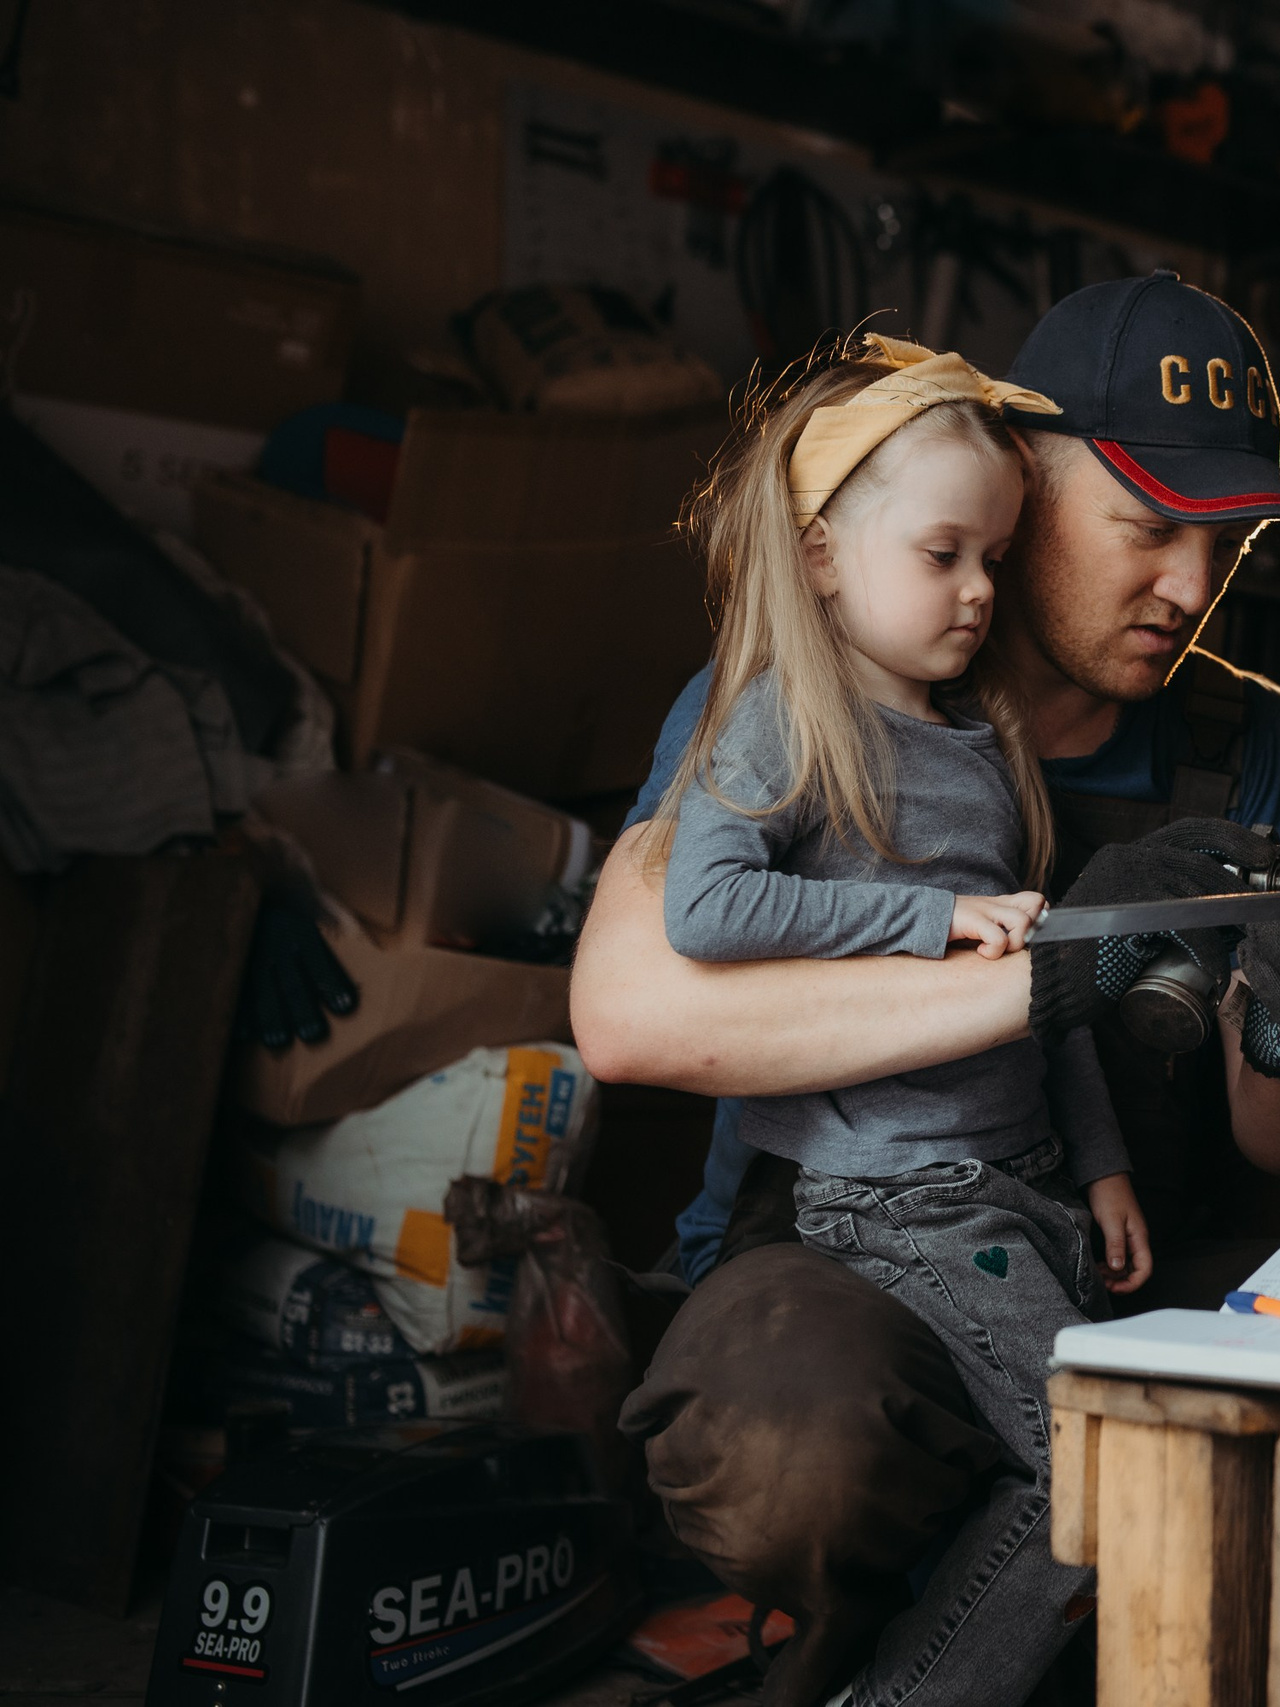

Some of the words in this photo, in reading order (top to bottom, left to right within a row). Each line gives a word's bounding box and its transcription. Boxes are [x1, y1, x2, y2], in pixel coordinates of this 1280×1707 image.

[200, 1579, 271, 1635] 9.9
[369, 1537, 575, 1646] SEA-PRO
[194, 1630, 261, 1663] SEA-PRO
[382, 1659, 409, 1672] Two
